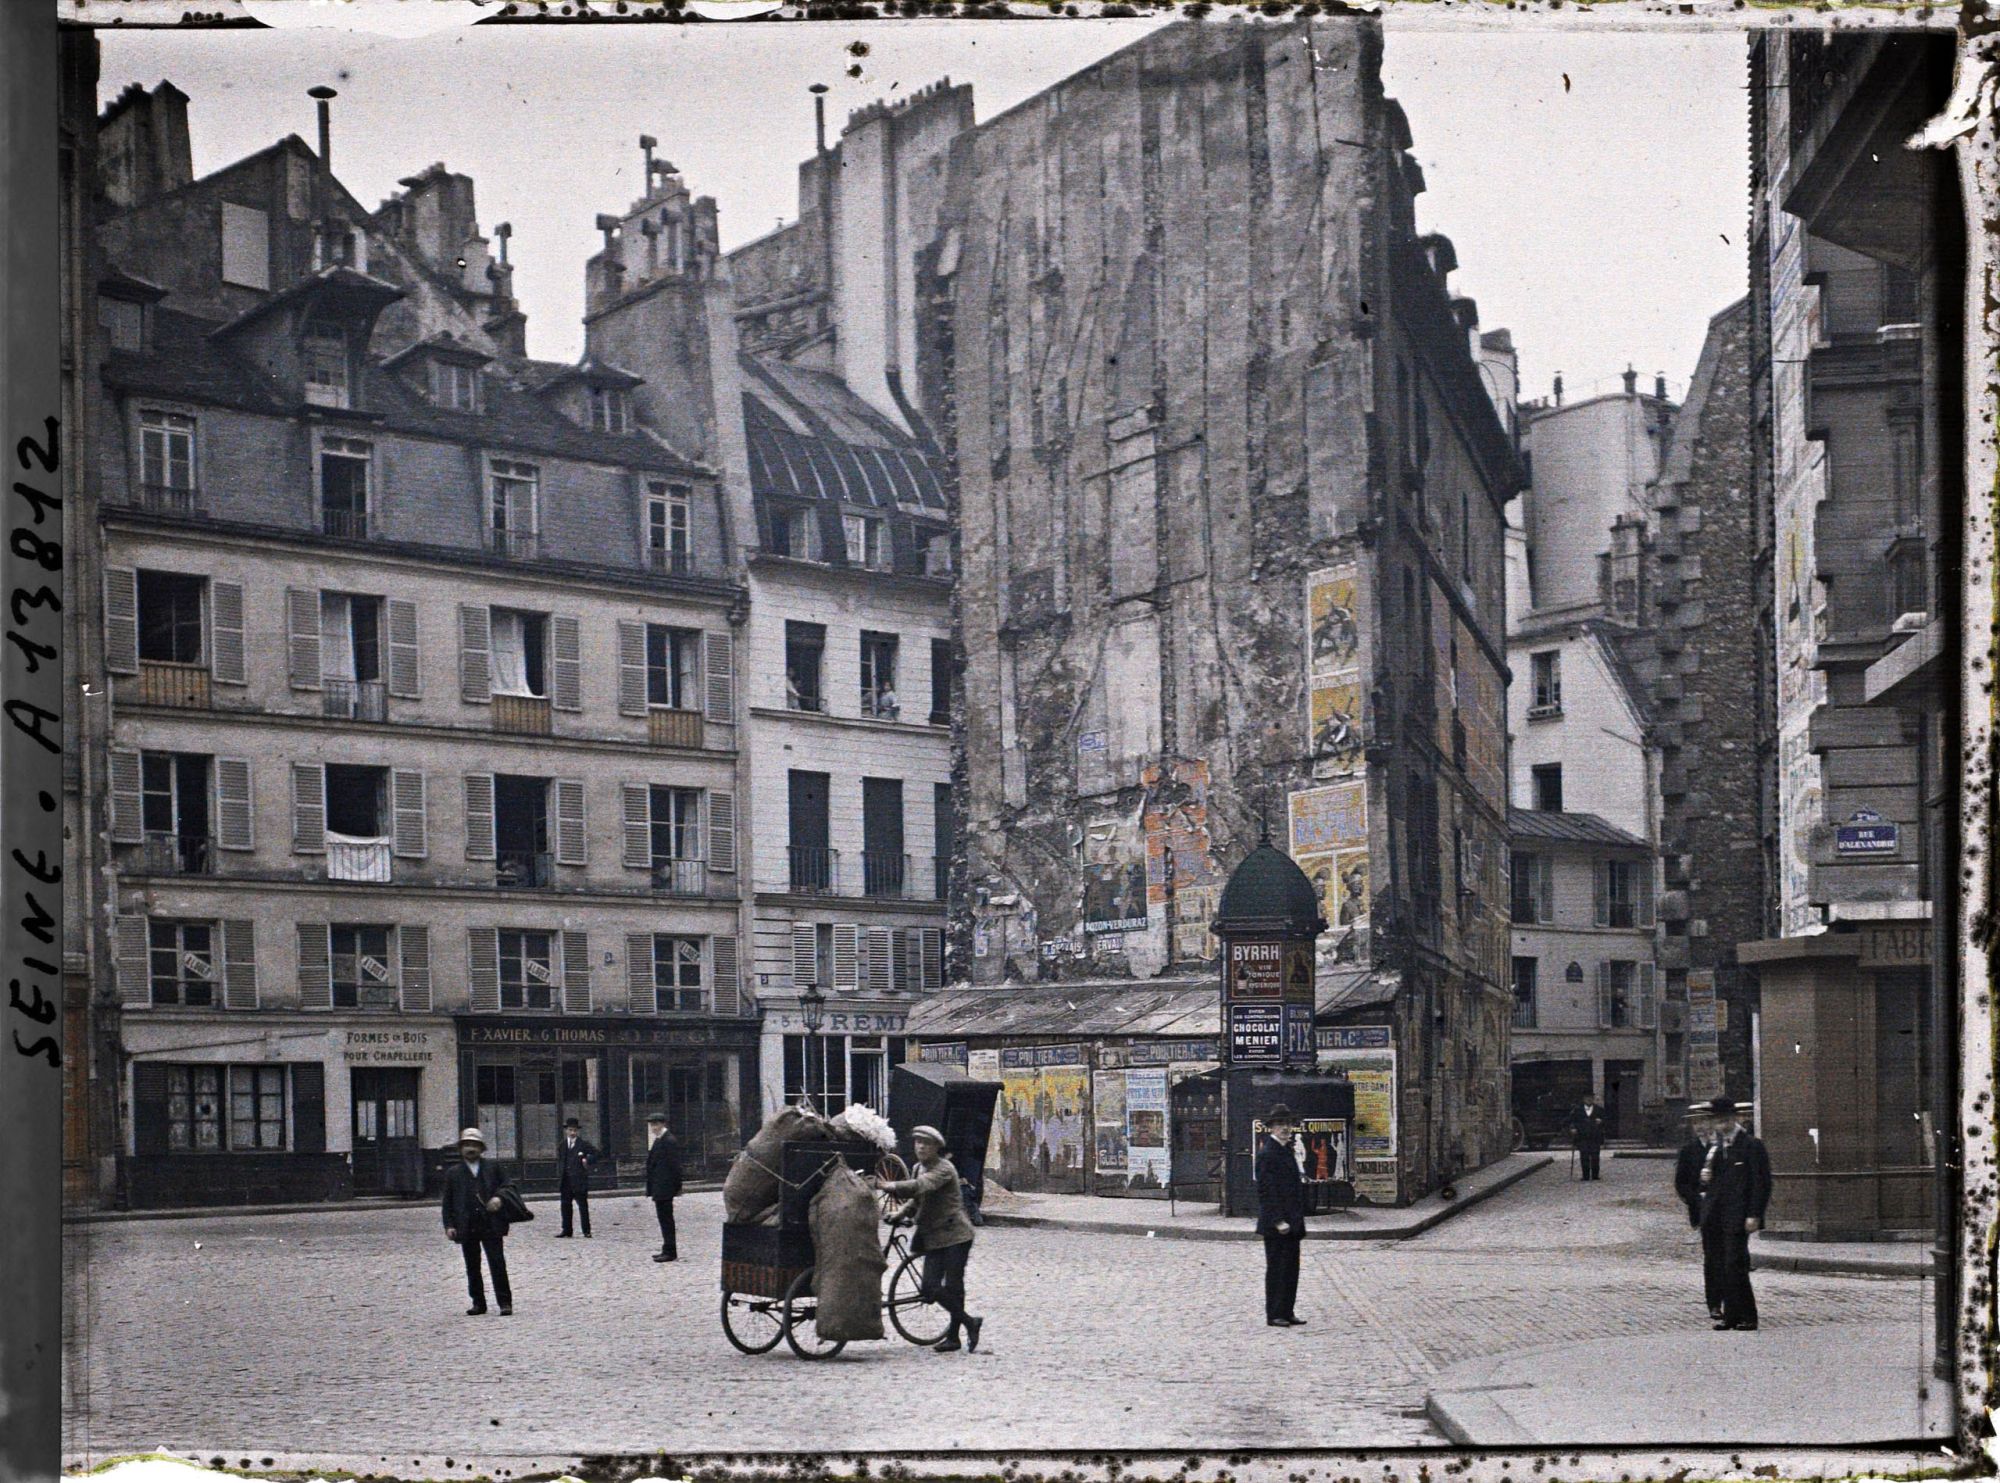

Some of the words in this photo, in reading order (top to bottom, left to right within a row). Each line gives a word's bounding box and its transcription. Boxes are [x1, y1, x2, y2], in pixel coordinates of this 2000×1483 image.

[11, 415, 63, 677] 13812
[3, 697, 61, 755] A
[1858, 831, 1875, 839] RUE
[1839, 839, 1895, 849] D'ALEXANDRIE
[10, 847, 62, 1068] SEINE
[1234, 945, 1279, 961] BYRRH
[483, 1028, 532, 1042] XAVIER
[553, 1027, 606, 1043] THOMAS
[1233, 1023, 1280, 1033] CHOCOLAT
[347, 1032, 389, 1044] FORMES
[403, 1032, 428, 1043] BOIS
[1235, 1036, 1278, 1045] MENIER
[1288, 1022, 1311, 1052] FIX
[1315, 1031, 1342, 1047] TIER
[343, 1052, 368, 1060] POUR
[373, 1051, 432, 1061] CHAPELLERIE
